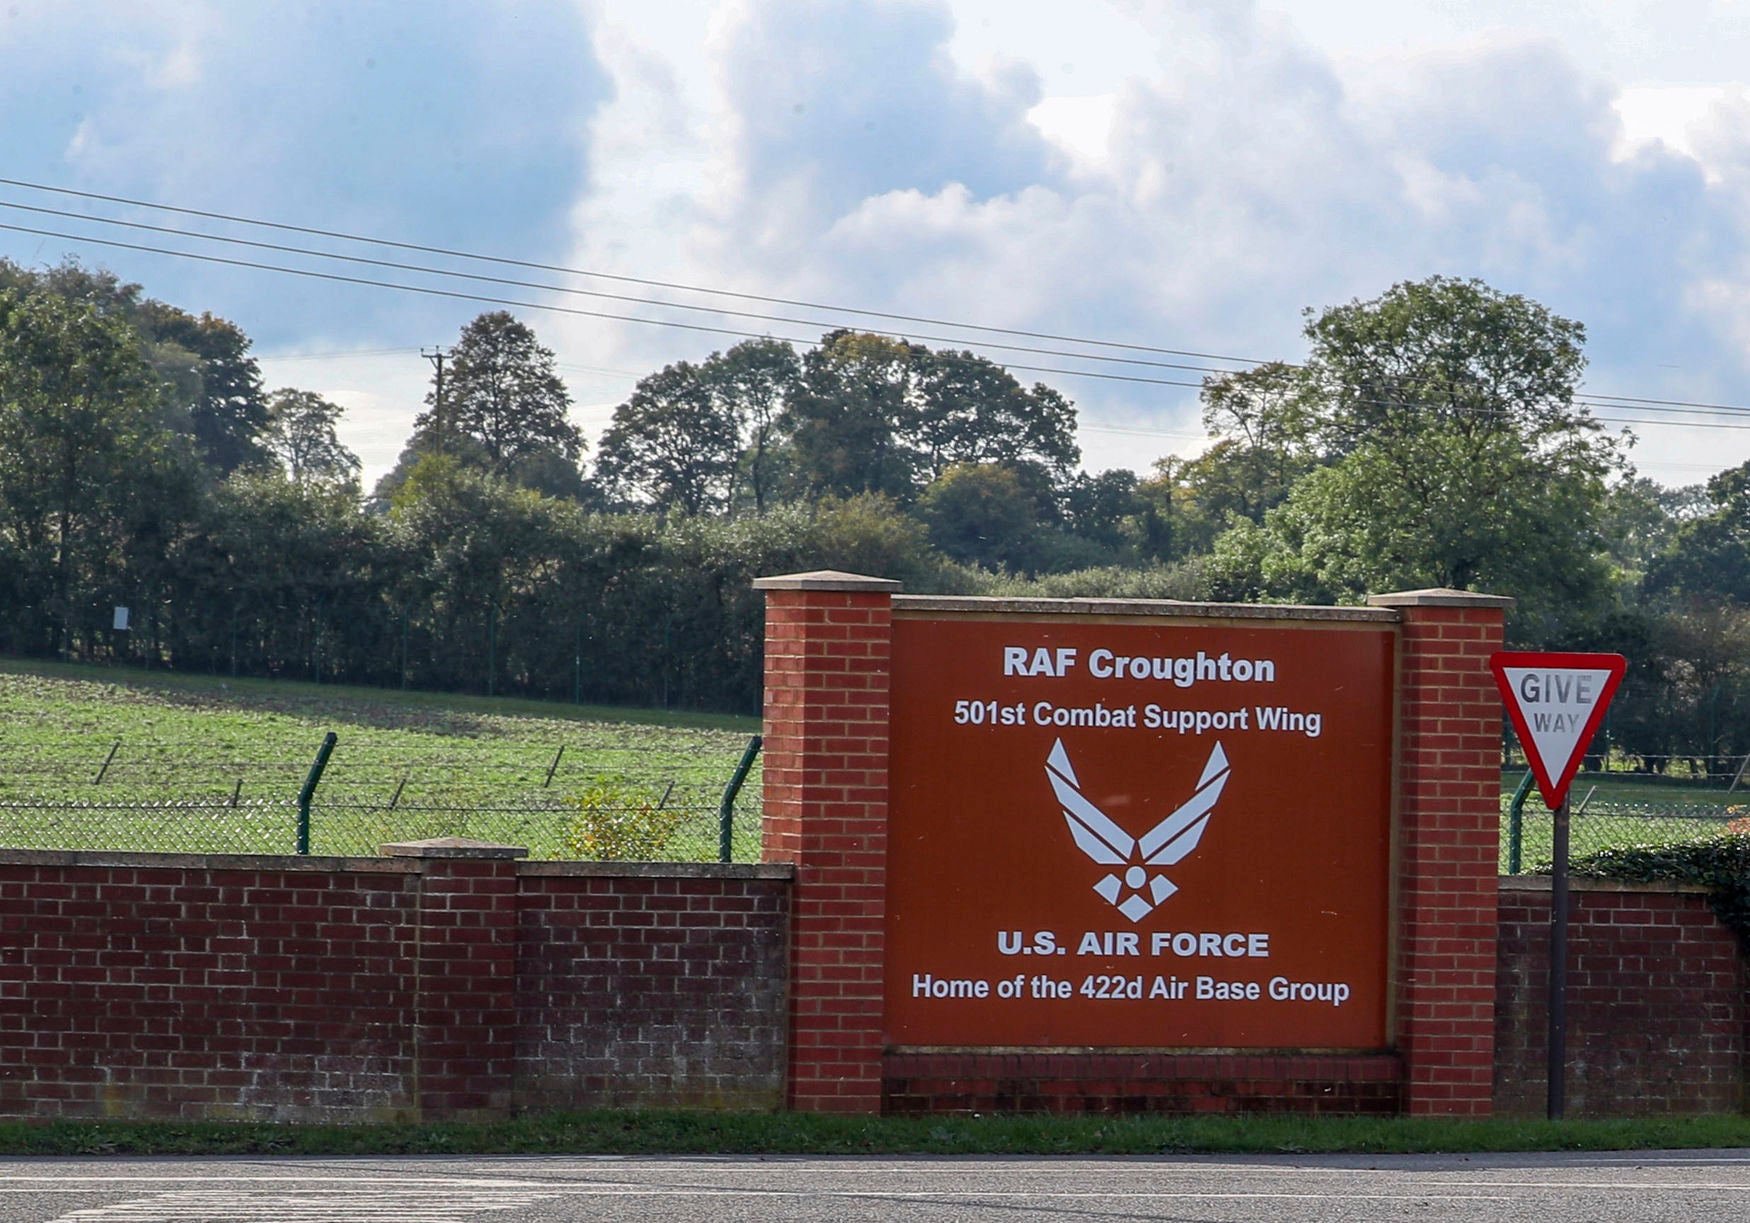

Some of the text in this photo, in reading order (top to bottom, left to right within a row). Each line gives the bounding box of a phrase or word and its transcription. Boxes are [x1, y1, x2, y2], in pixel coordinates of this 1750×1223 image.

[1003, 646, 1275, 688] RAF Croughton
[1521, 673, 1593, 704] GIVE
[954, 700, 1321, 738] 501st Combat Support Wing
[1533, 712, 1580, 733] WAY
[997, 931, 1269, 957] U.S. AIR FORCE
[912, 973, 1350, 1007] Home of the 422d Air Base Group
